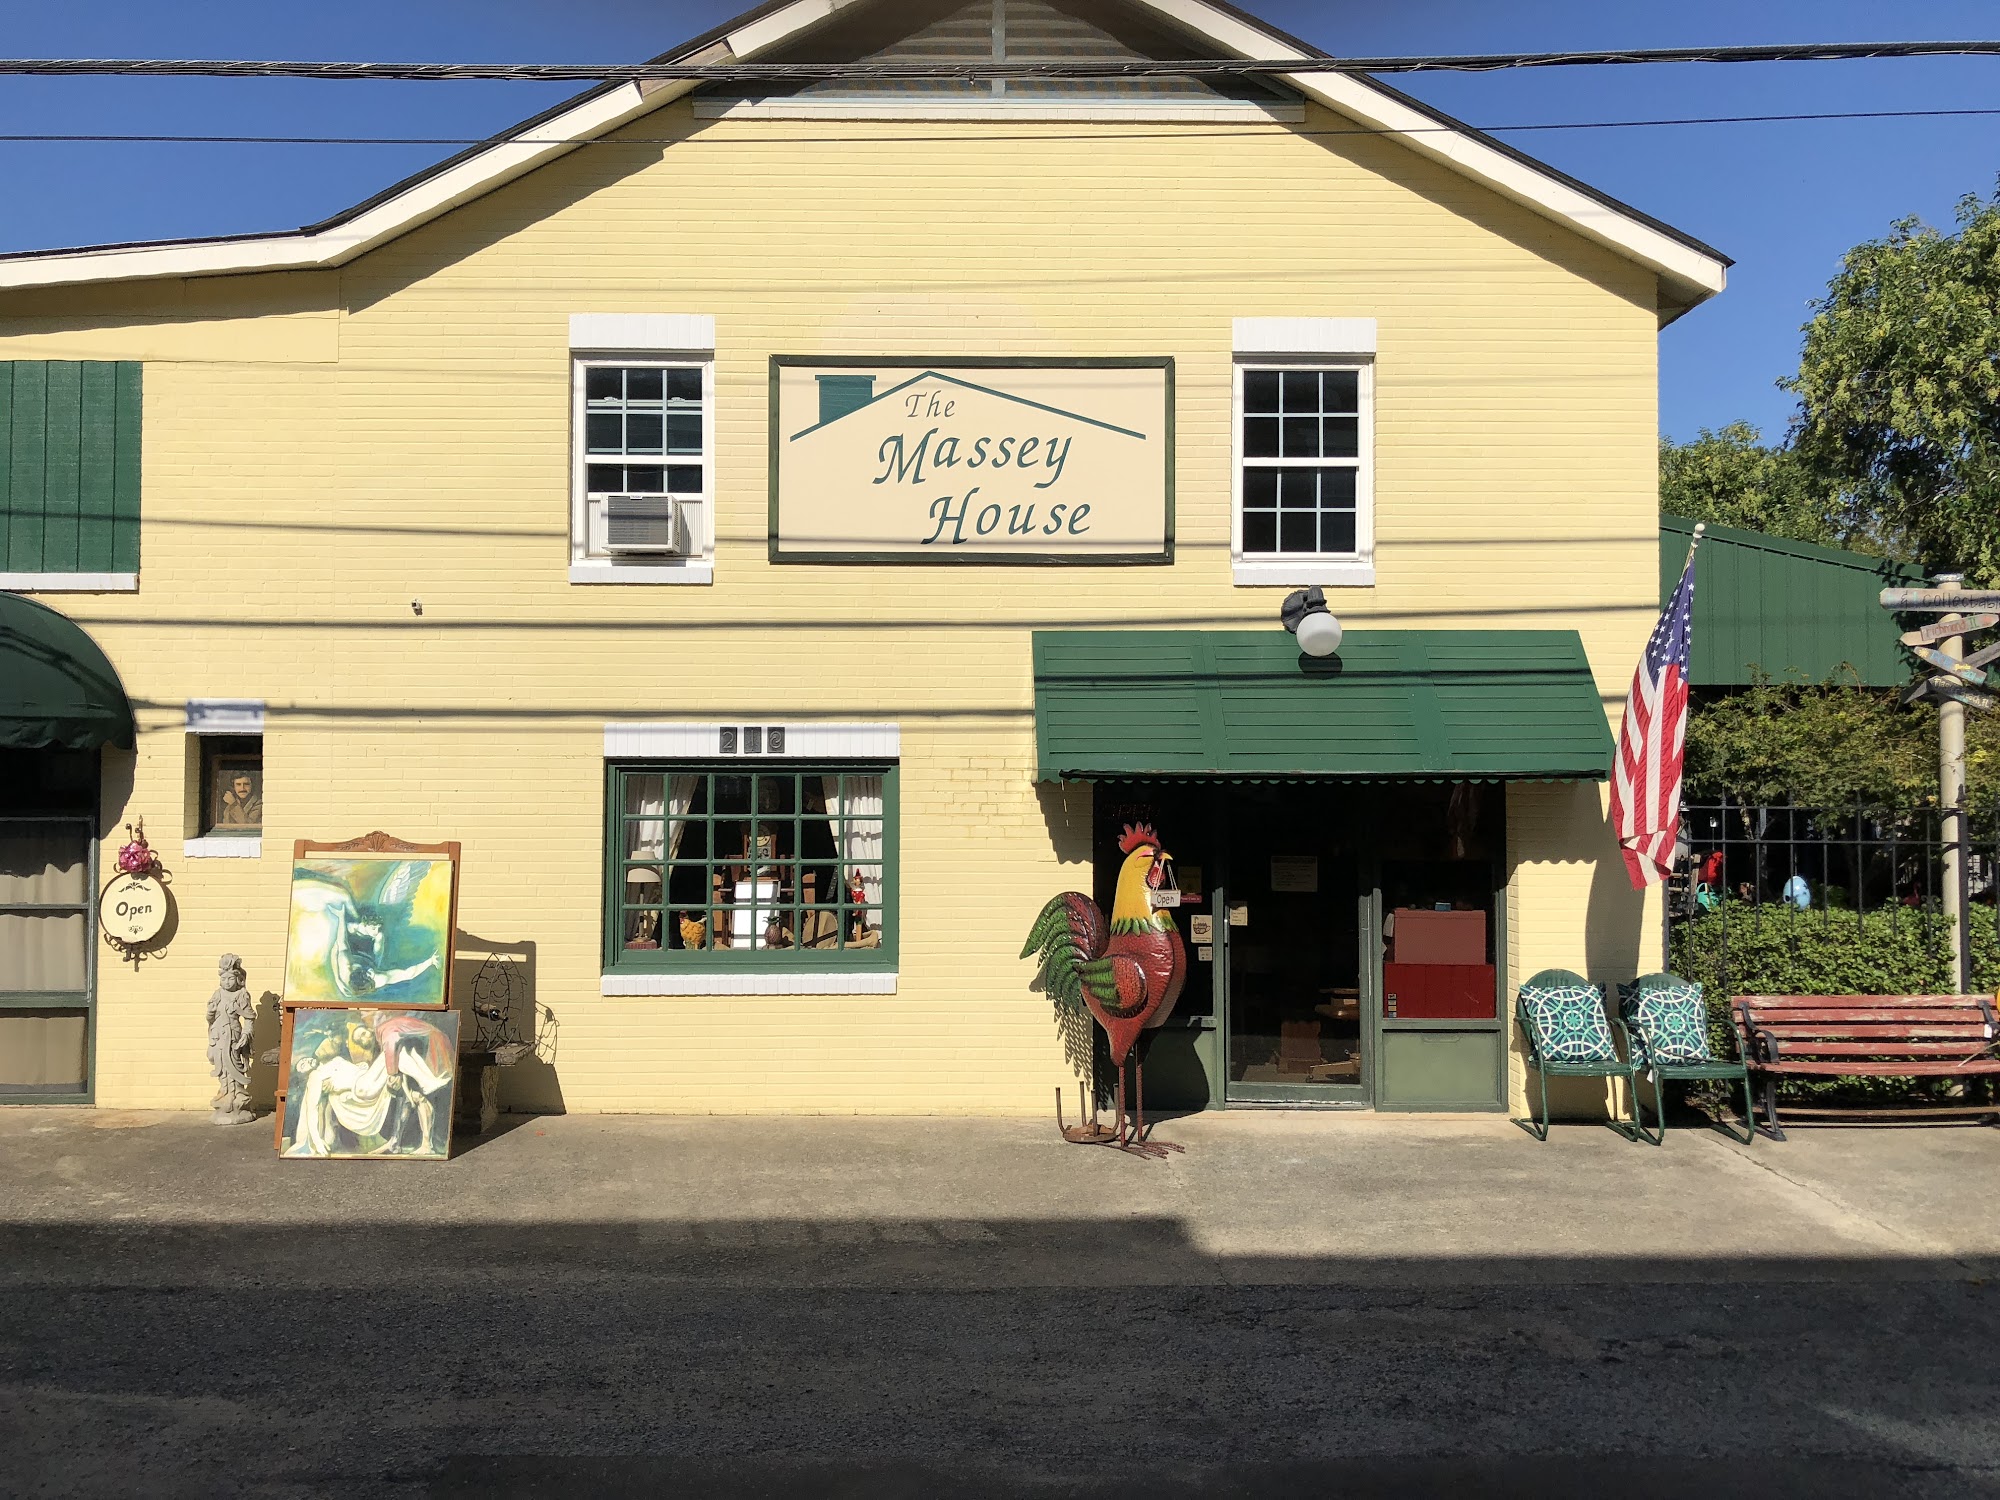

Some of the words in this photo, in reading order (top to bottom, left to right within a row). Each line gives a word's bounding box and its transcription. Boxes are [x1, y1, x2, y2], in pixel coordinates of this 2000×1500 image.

[904, 390, 956, 419] The
[871, 427, 1073, 489] Massey
[920, 487, 1091, 545] House
[721, 729, 783, 750] 218
[115, 901, 153, 922] Open
[1156, 894, 1175, 906] Open
